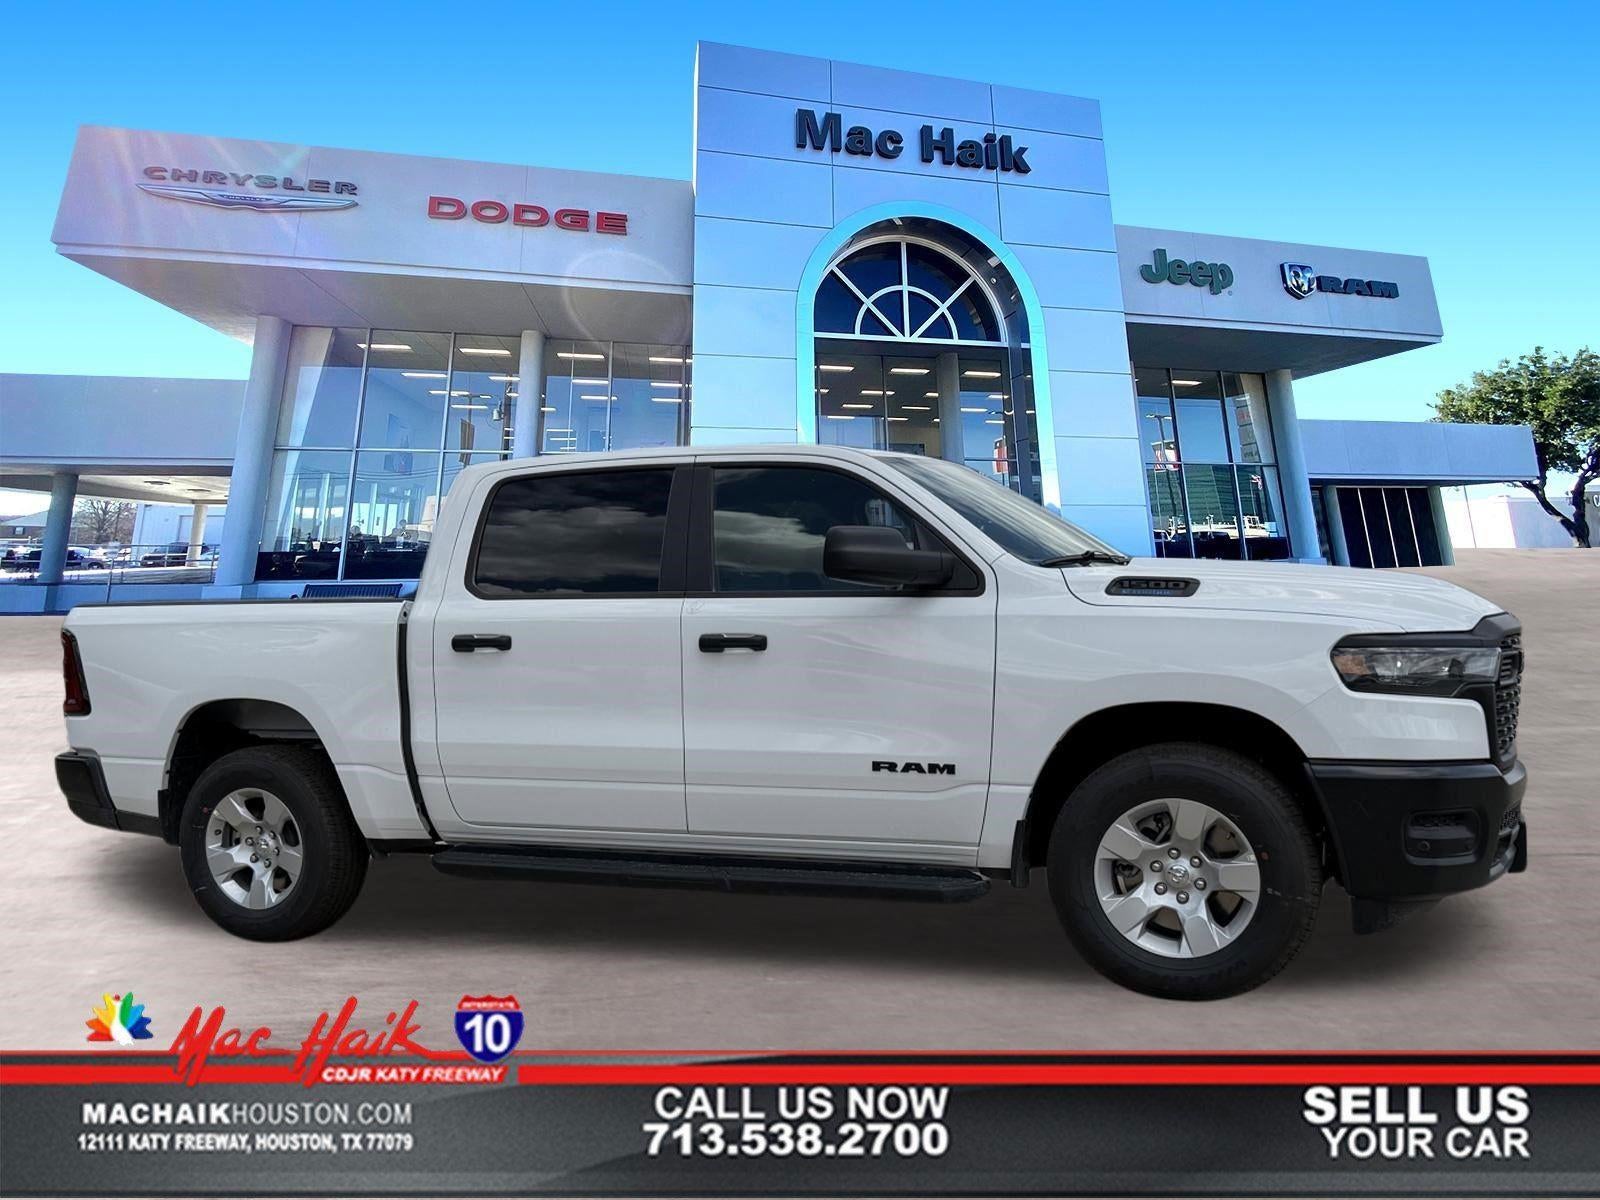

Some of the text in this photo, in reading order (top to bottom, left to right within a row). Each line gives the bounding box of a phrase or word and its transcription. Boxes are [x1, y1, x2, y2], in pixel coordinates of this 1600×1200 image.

[795, 108, 1032, 174] Mac Haik
[143, 166, 358, 196] CHRYSLER
[428, 195, 629, 235] DODGE
[1139, 248, 1234, 295] Jeep
[1315, 275, 1400, 299] RAM
[871, 760, 956, 775] RAM
